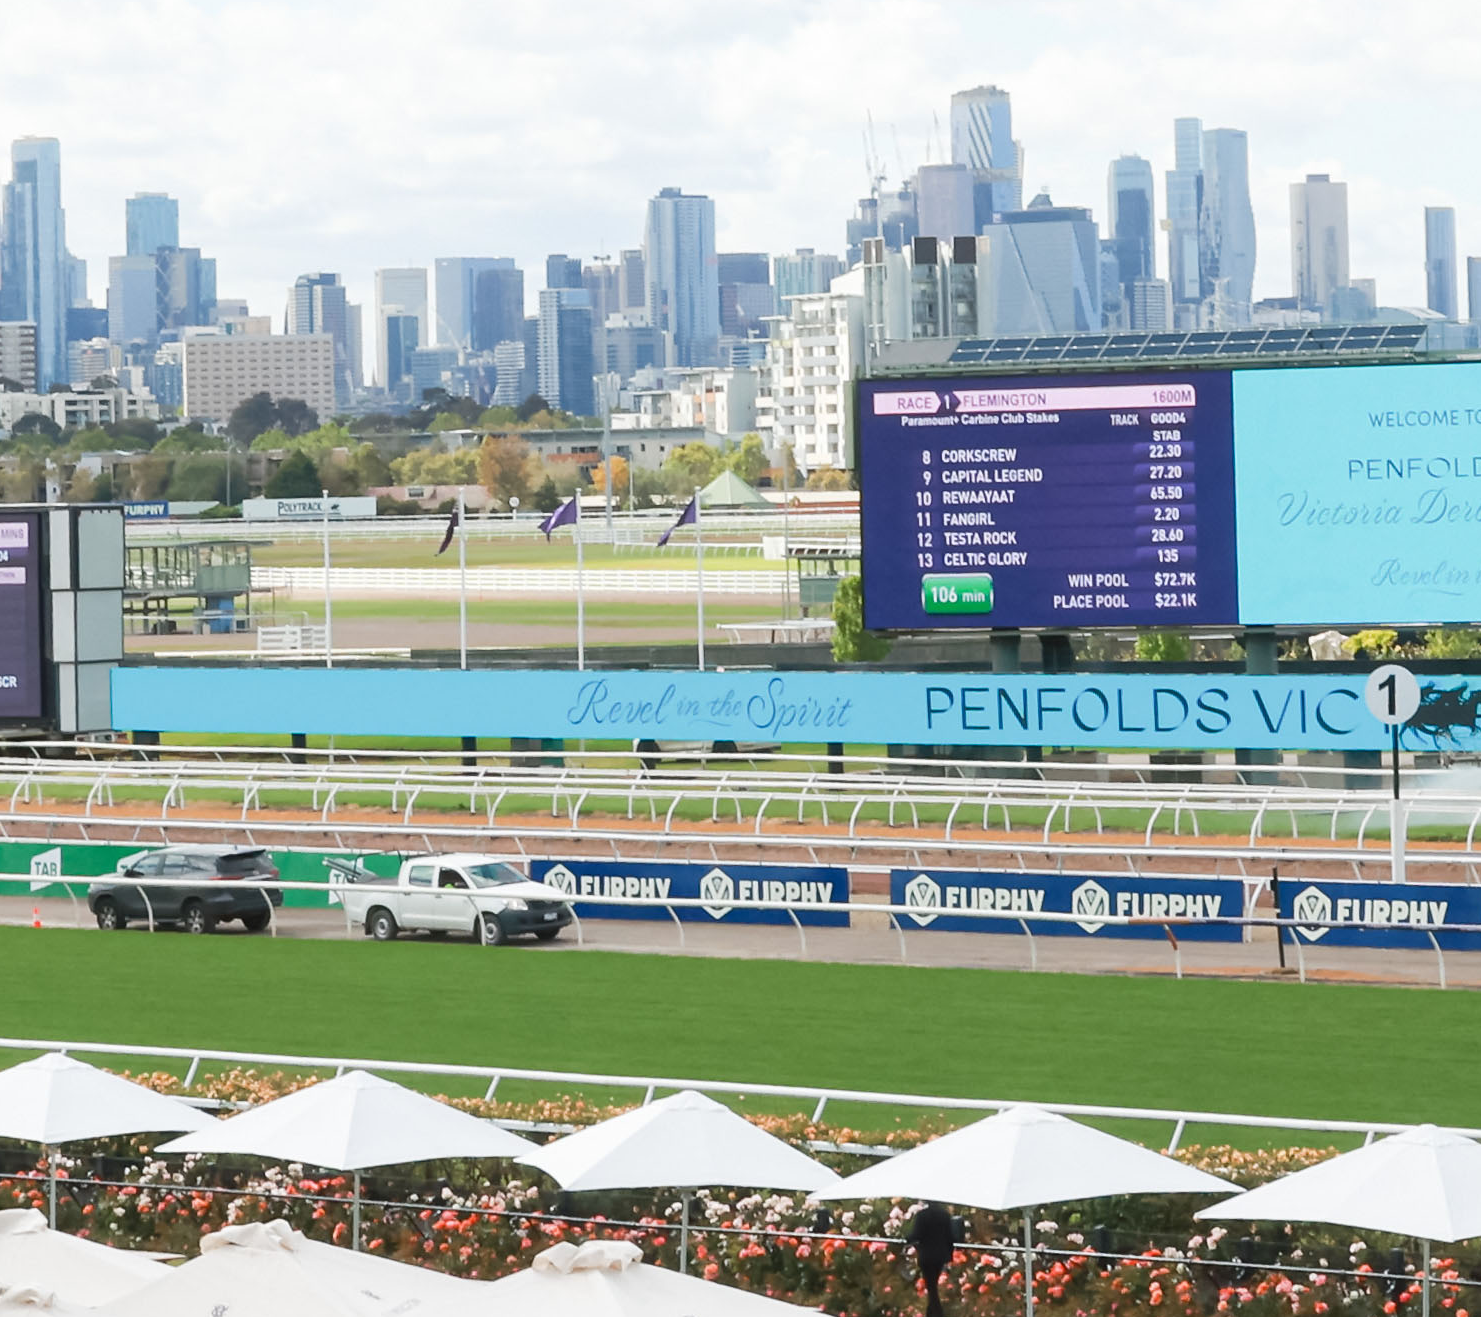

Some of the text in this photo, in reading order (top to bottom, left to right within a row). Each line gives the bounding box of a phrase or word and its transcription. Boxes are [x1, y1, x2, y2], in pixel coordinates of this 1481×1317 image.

[897, 391, 1192, 409] RACE 1 FLEMINGTON 1600M
[901, 412, 1186, 427] Paramount+ Carbine Club Stakes TRACK GOOD4
[1368, 410, 1459, 428] WELCOME
[1153, 430, 1181, 441] STAB
[922, 444, 1181, 465] 8 CORKSCREW 22.30
[923, 466, 1182, 485] 9 CAPITAL LEGEND 27.20
[916, 486, 1182, 506] 10 REWAAYAAT 65.50
[278, 501, 322, 513] POLYTRACK
[916, 507, 1179, 527] 11 FANGIRL 2.20
[1276, 489, 1403, 527] Victoria
[917, 529, 1184, 547] 12 TESTA ROCK 28.60
[918, 549, 1179, 568] 13 CELTIC GLORY 135
[1068, 572, 1196, 588] WIN POOL $72.7K
[1371, 557, 1447, 586] Revel
[1448, 565, 1469, 585] in
[931, 586, 985, 603] 106 min
[1053, 593, 1197, 609] PLACE POOL $22.1K
[1378, 674, 1396, 716] 1
[567, 677, 853, 739] Revel in the Spirit
[925, 687, 1232, 734] PENFOLDS
[35, 862, 58, 877] TAB
[581, 876, 670, 899] FURPHY
[740, 881, 833, 904] FURPHY
[946, 887, 1044, 913] FURPHY
[1117, 892, 1222, 920] FURPHY
[1337, 898, 1447, 925] FURPHY
